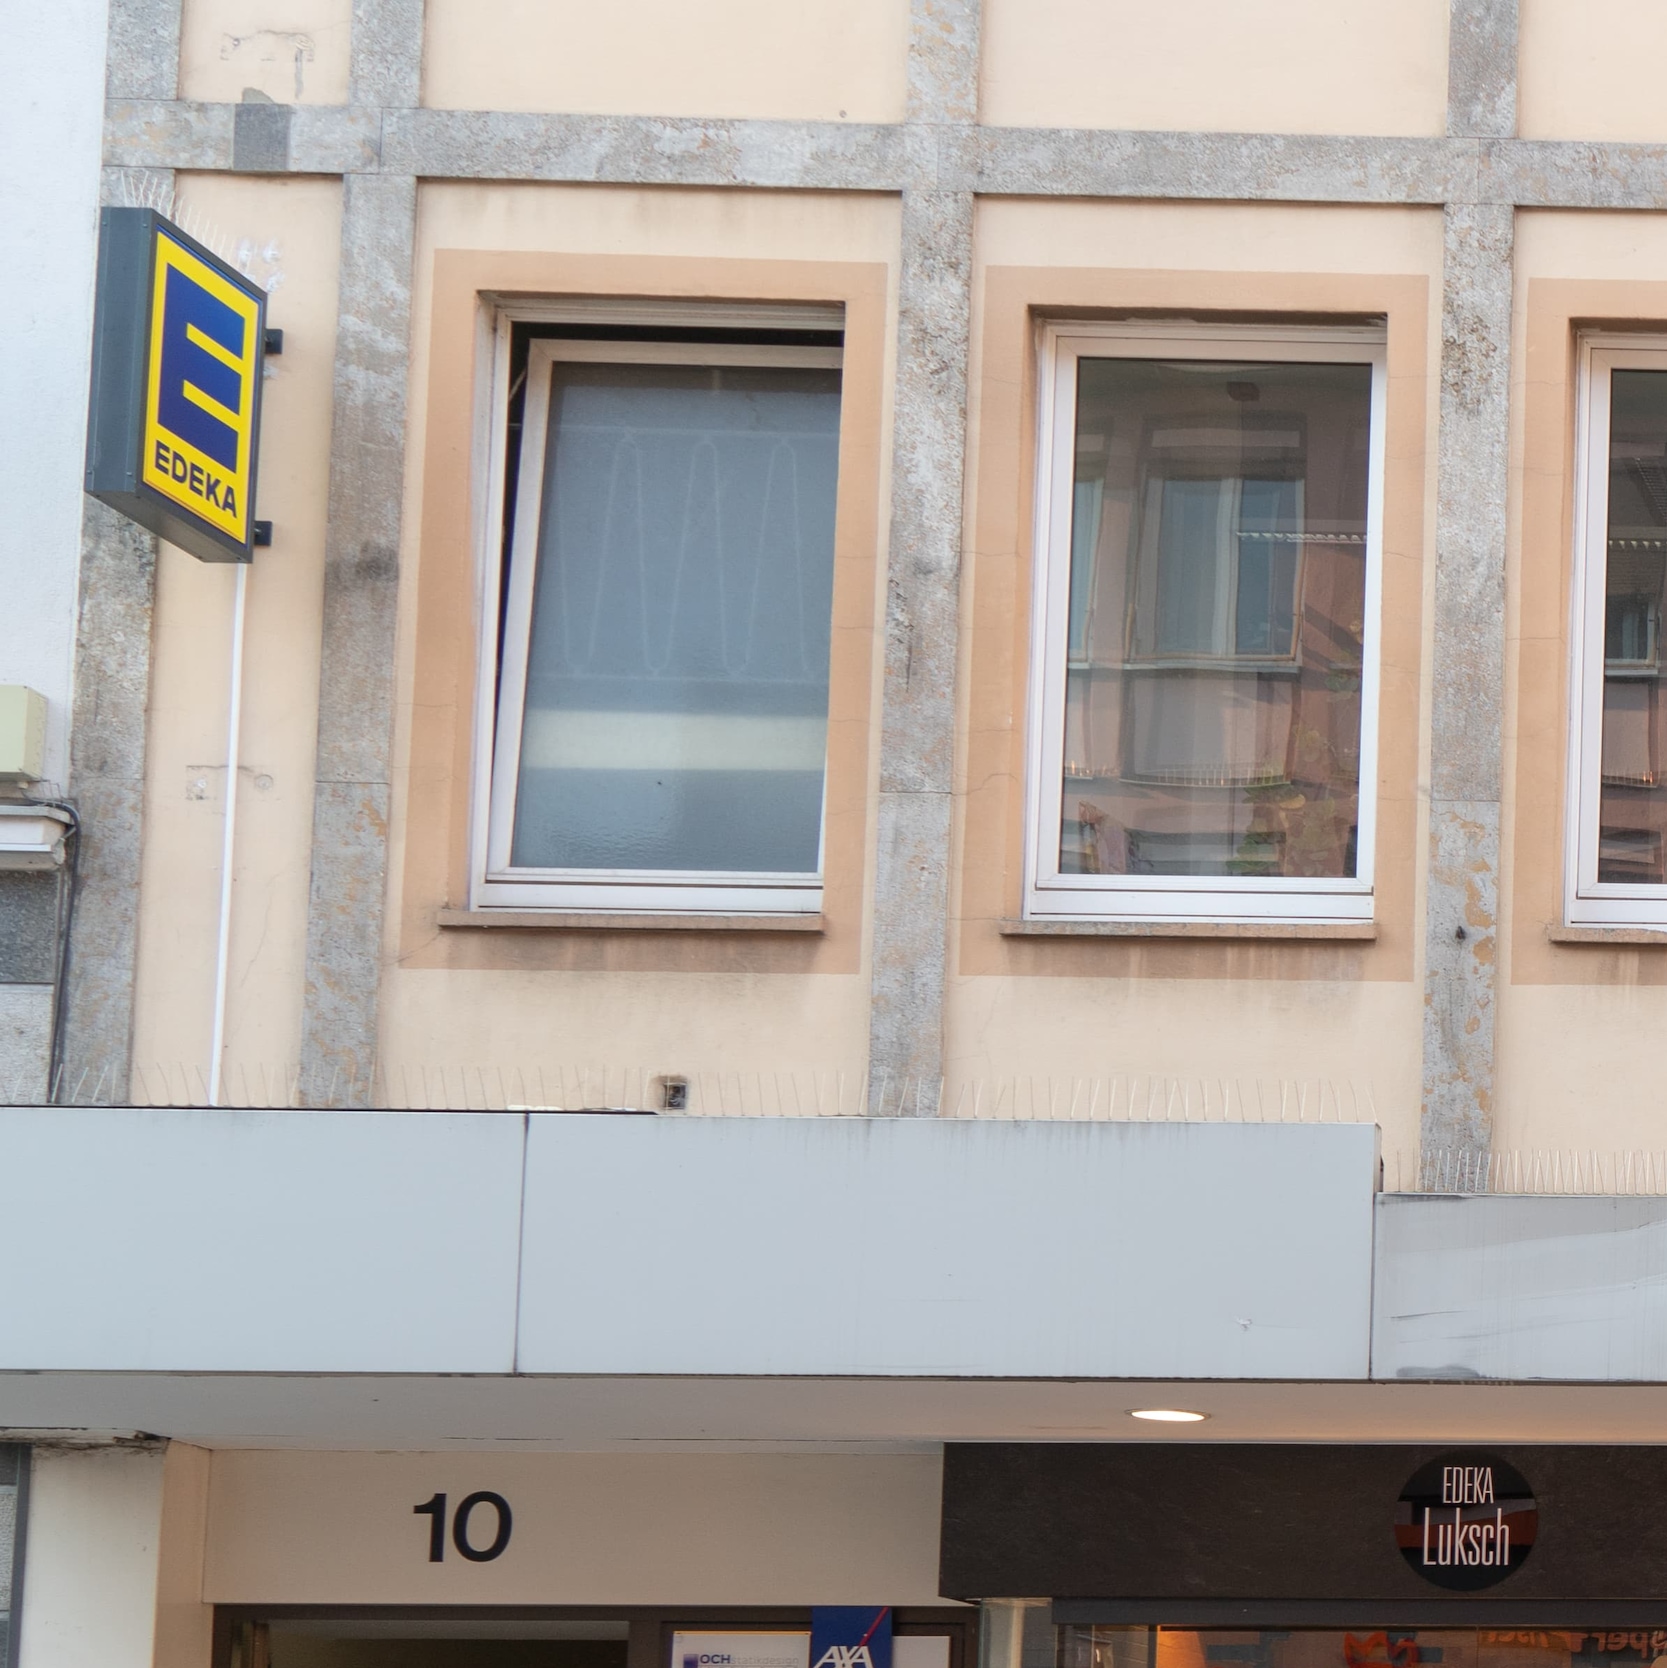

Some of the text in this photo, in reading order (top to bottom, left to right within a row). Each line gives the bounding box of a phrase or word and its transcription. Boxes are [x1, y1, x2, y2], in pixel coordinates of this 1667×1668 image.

[155, 440, 237, 519] EDEKA
[1442, 1466, 1494, 1504] EDEKA
[413, 1490, 512, 1562] 10
[1423, 1507, 1510, 1566] Luksch
